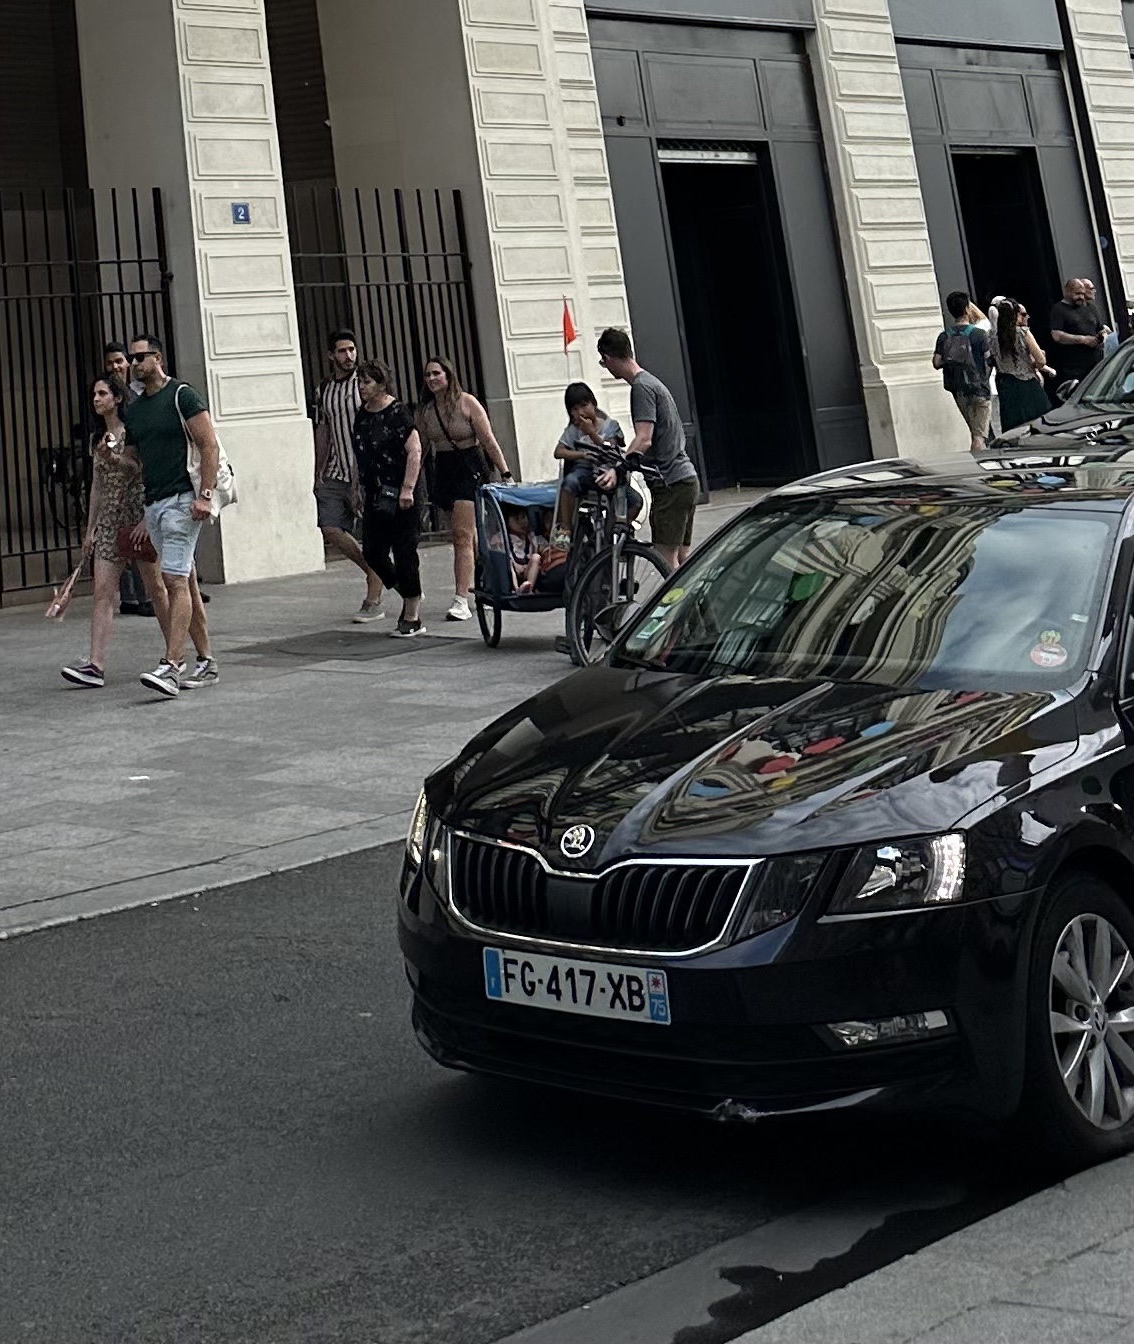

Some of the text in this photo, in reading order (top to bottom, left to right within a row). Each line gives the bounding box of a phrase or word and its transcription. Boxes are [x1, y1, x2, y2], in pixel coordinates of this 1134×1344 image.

[237, 206, 245, 220] 2
[503, 957, 646, 1012] FG-417-XB
[651, 999, 666, 1016] 75
